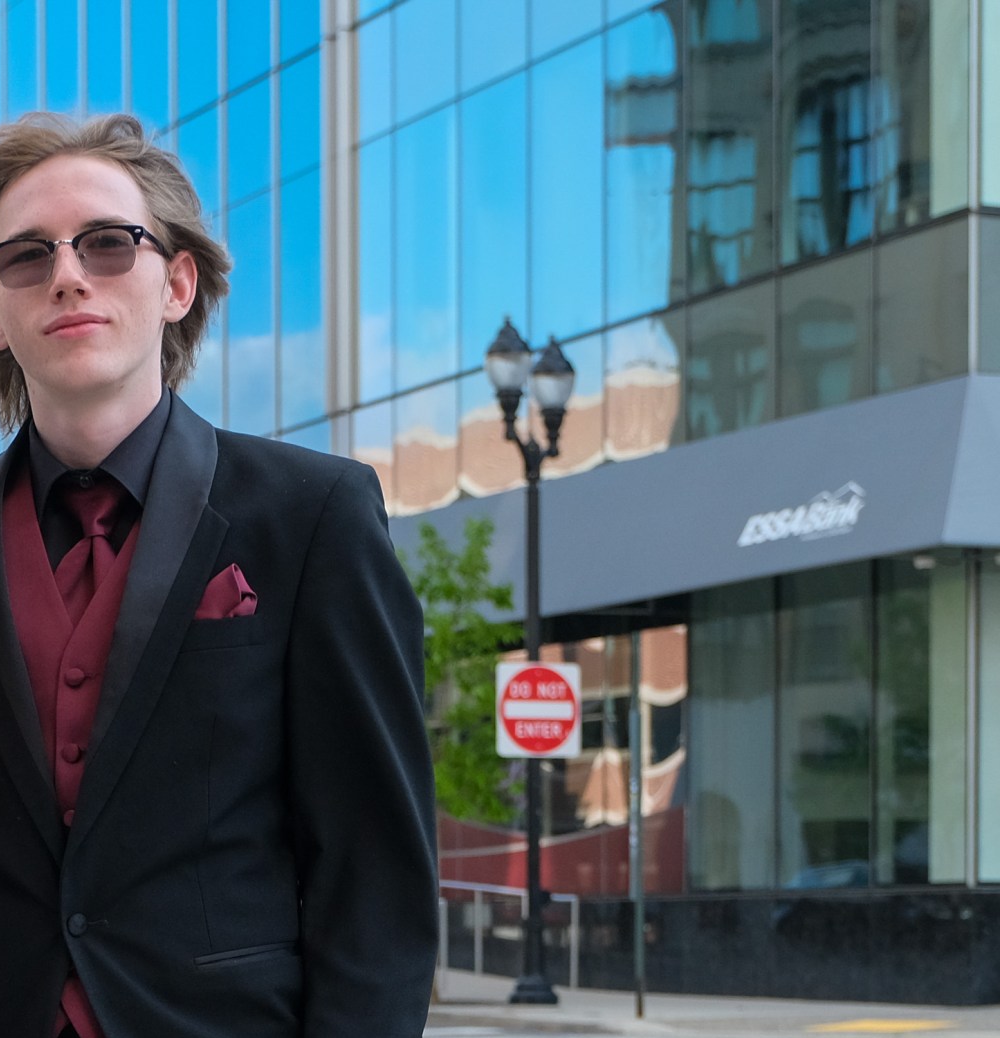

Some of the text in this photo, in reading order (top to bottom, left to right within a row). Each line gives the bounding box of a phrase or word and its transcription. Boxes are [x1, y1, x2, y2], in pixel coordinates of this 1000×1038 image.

[509, 681, 566, 699] DO NOT
[515, 721, 562, 738] ENTER
